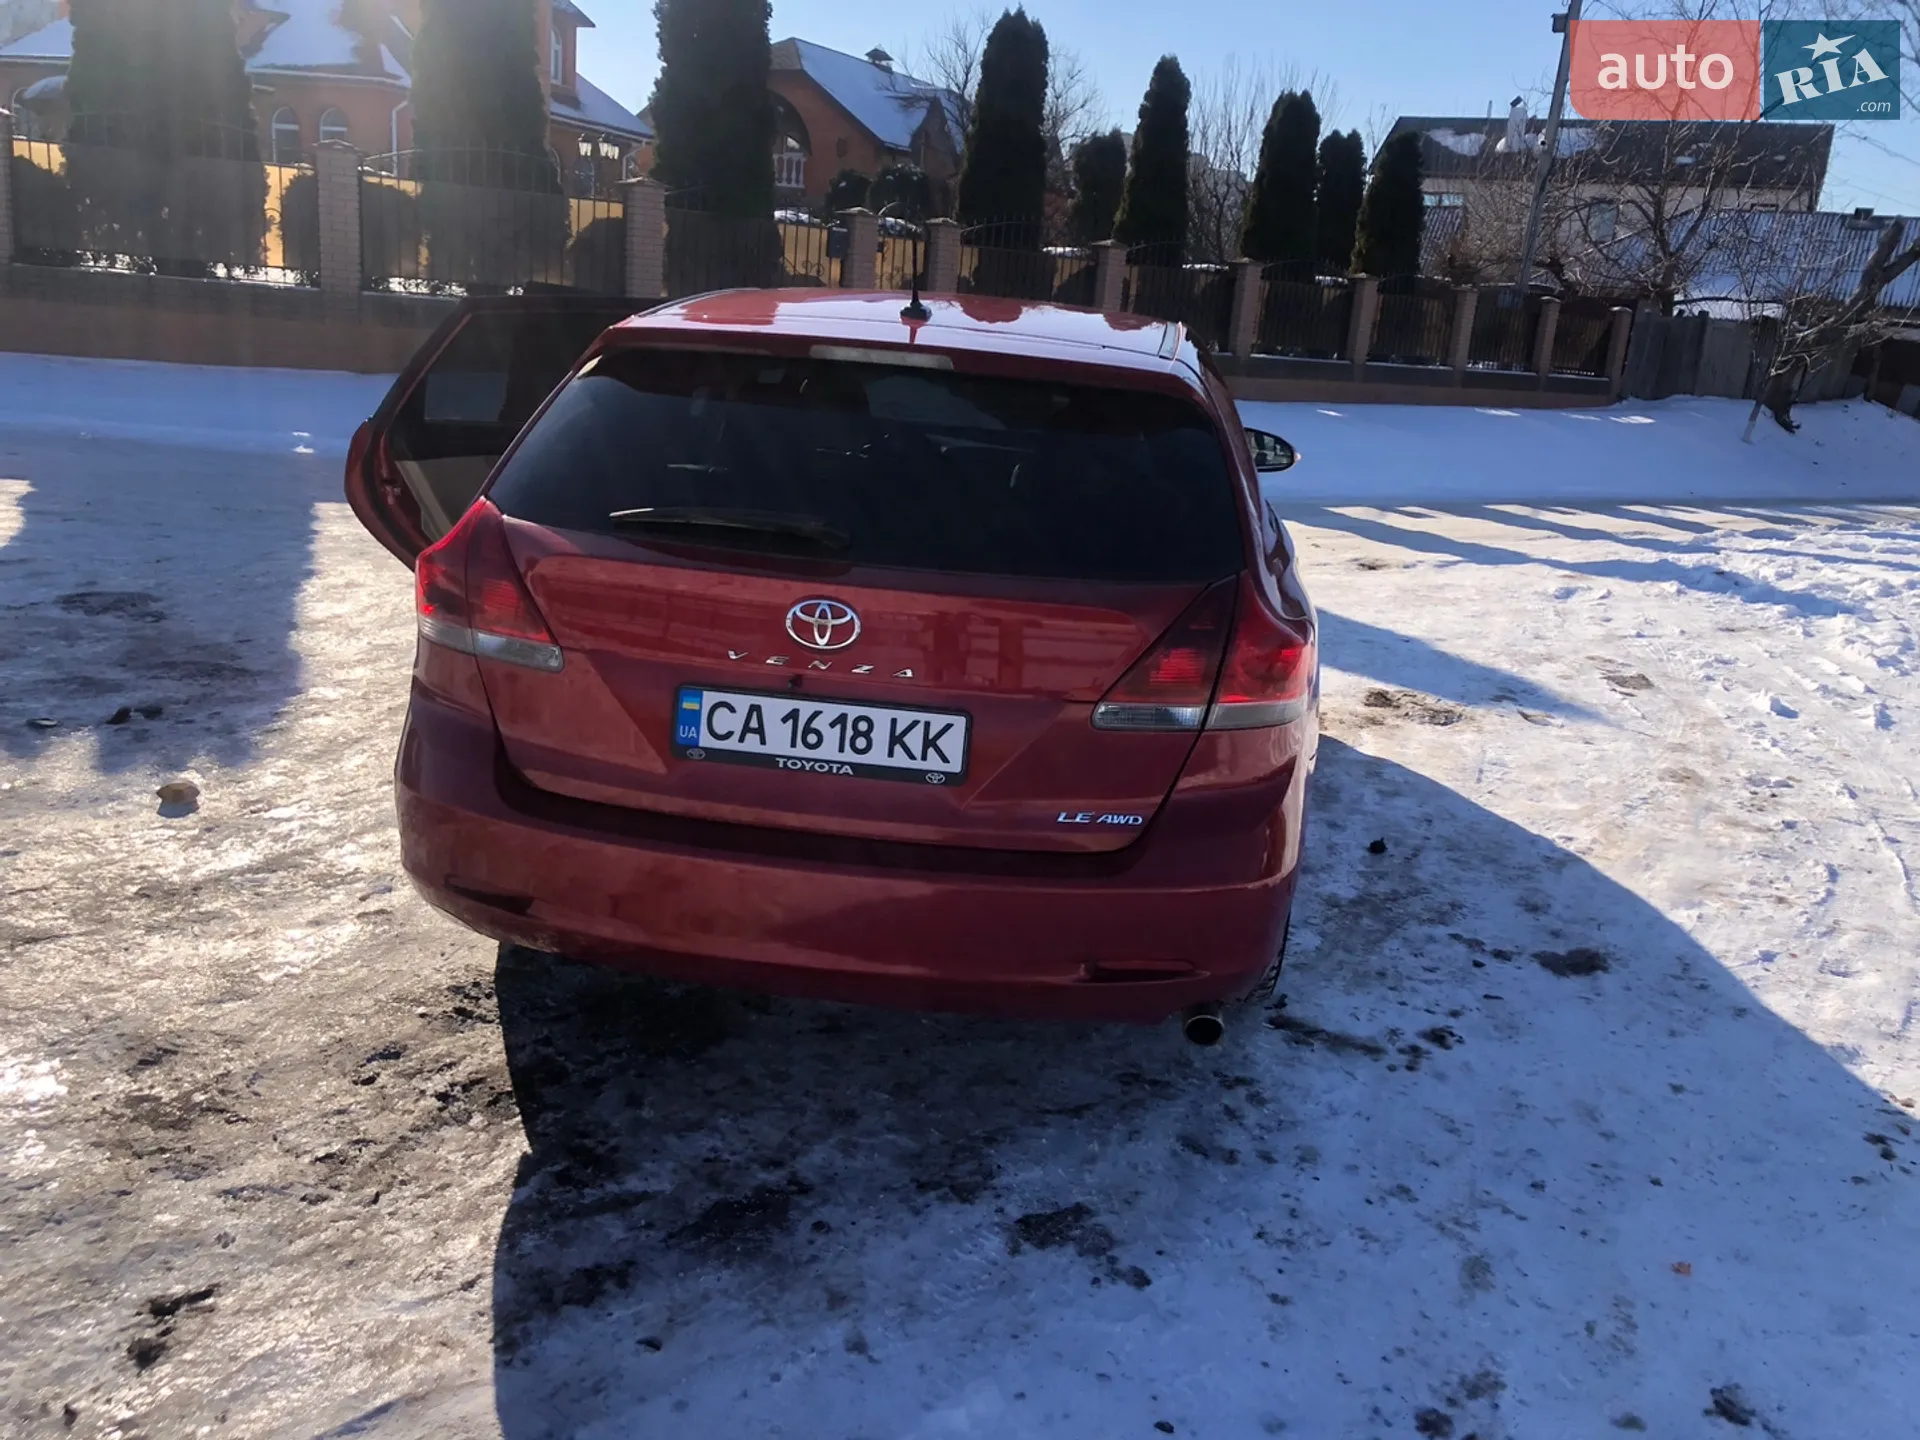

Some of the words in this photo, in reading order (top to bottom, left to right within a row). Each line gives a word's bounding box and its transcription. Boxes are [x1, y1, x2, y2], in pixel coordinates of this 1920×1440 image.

[727, 649, 914, 678] VENZA
[679, 725, 699, 739] UA
[706, 701, 767, 746] CA
[780, 707, 875, 756] 1618
[887, 717, 955, 764] KK
[775, 757, 854, 775] TOYOTA
[1056, 811, 1096, 824] LE
[1096, 813, 1144, 826] AWD
